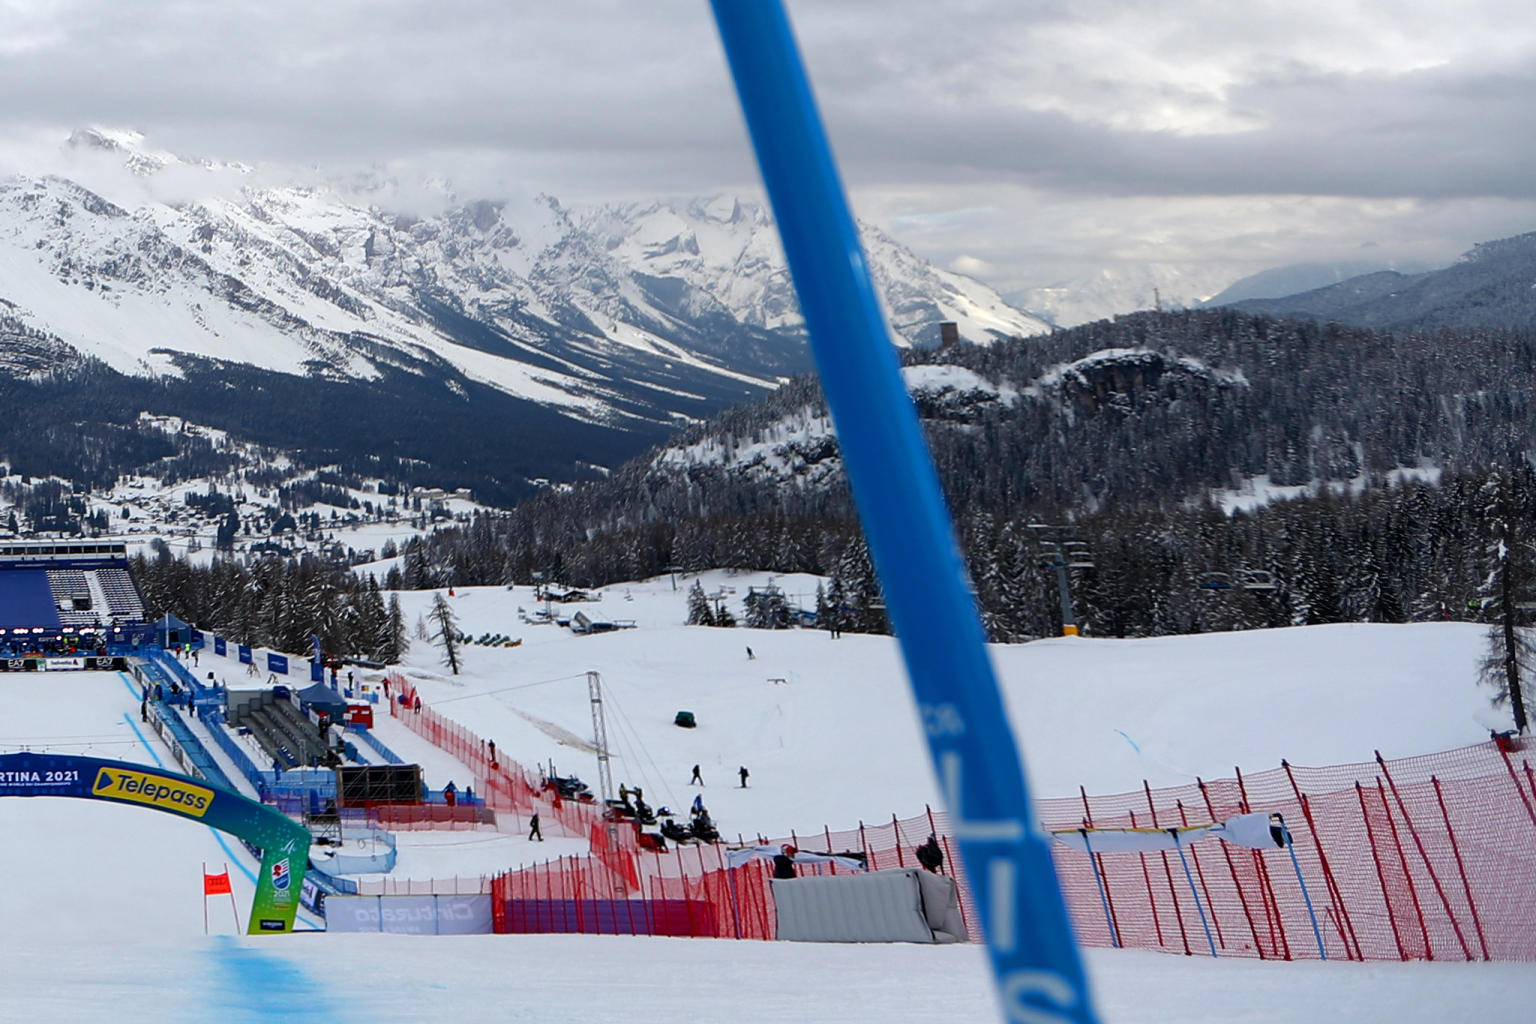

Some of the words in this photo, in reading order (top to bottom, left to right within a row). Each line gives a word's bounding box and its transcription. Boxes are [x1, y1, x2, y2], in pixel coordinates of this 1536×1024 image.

[7, 659, 25, 667] EA7
[96, 657, 113, 666] EA7
[45, 770, 79, 781] 2021
[117, 774, 207, 809] Telepass
